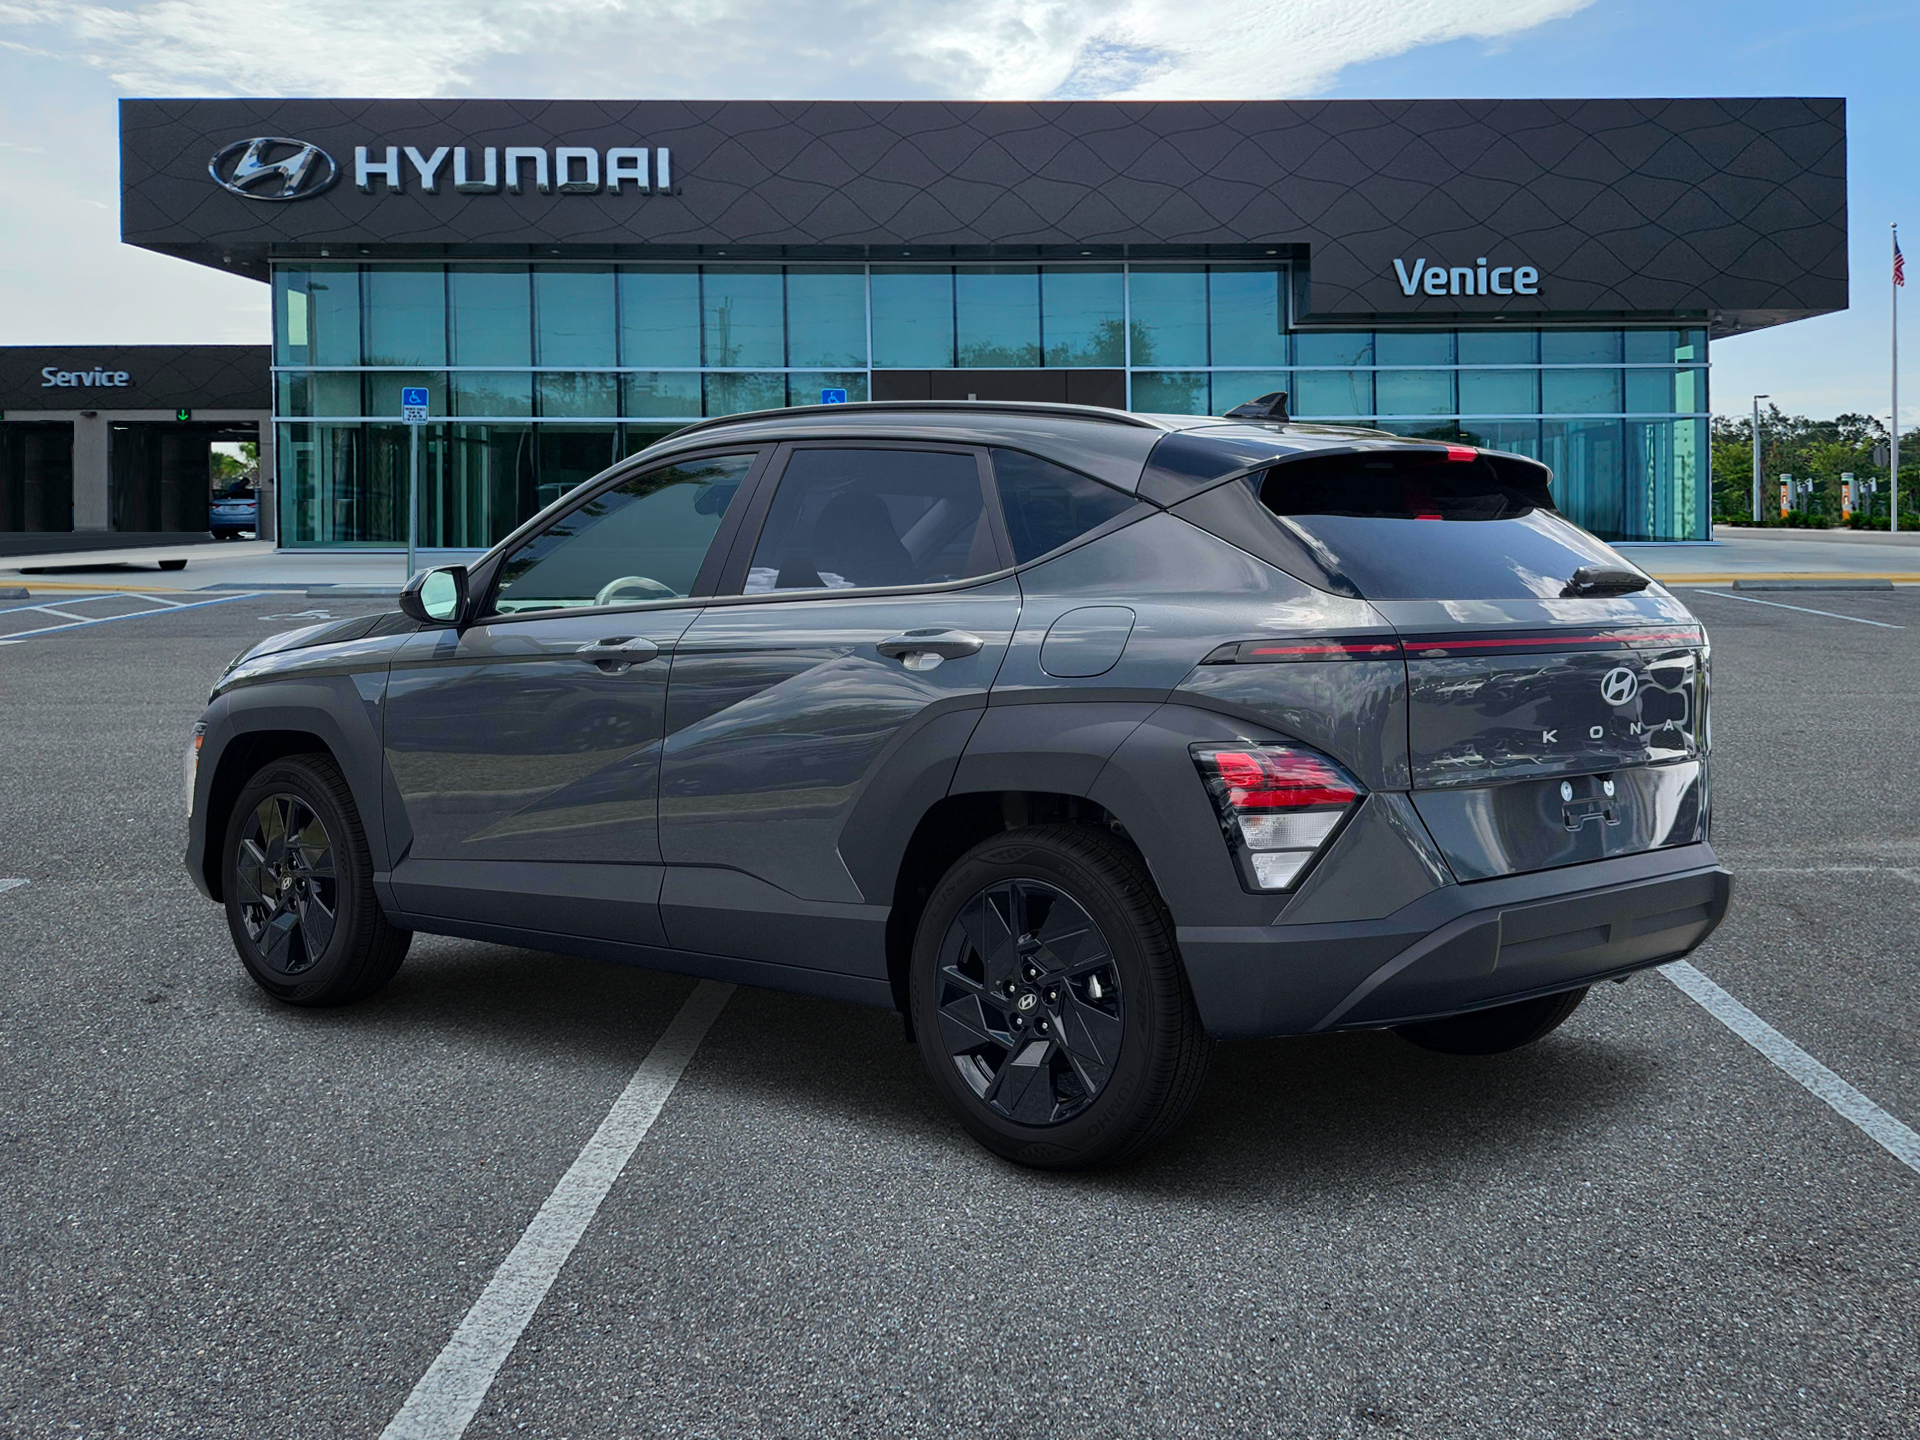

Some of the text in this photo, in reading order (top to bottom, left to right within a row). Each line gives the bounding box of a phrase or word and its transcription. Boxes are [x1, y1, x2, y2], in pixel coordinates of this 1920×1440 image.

[354, 146, 671, 194] HYUNDAI
[1392, 257, 1539, 296] Venice
[41, 366, 130, 388] Service
[1542, 718, 1674, 744] KONA
[1087, 1070, 1136, 1137] KUMHO
